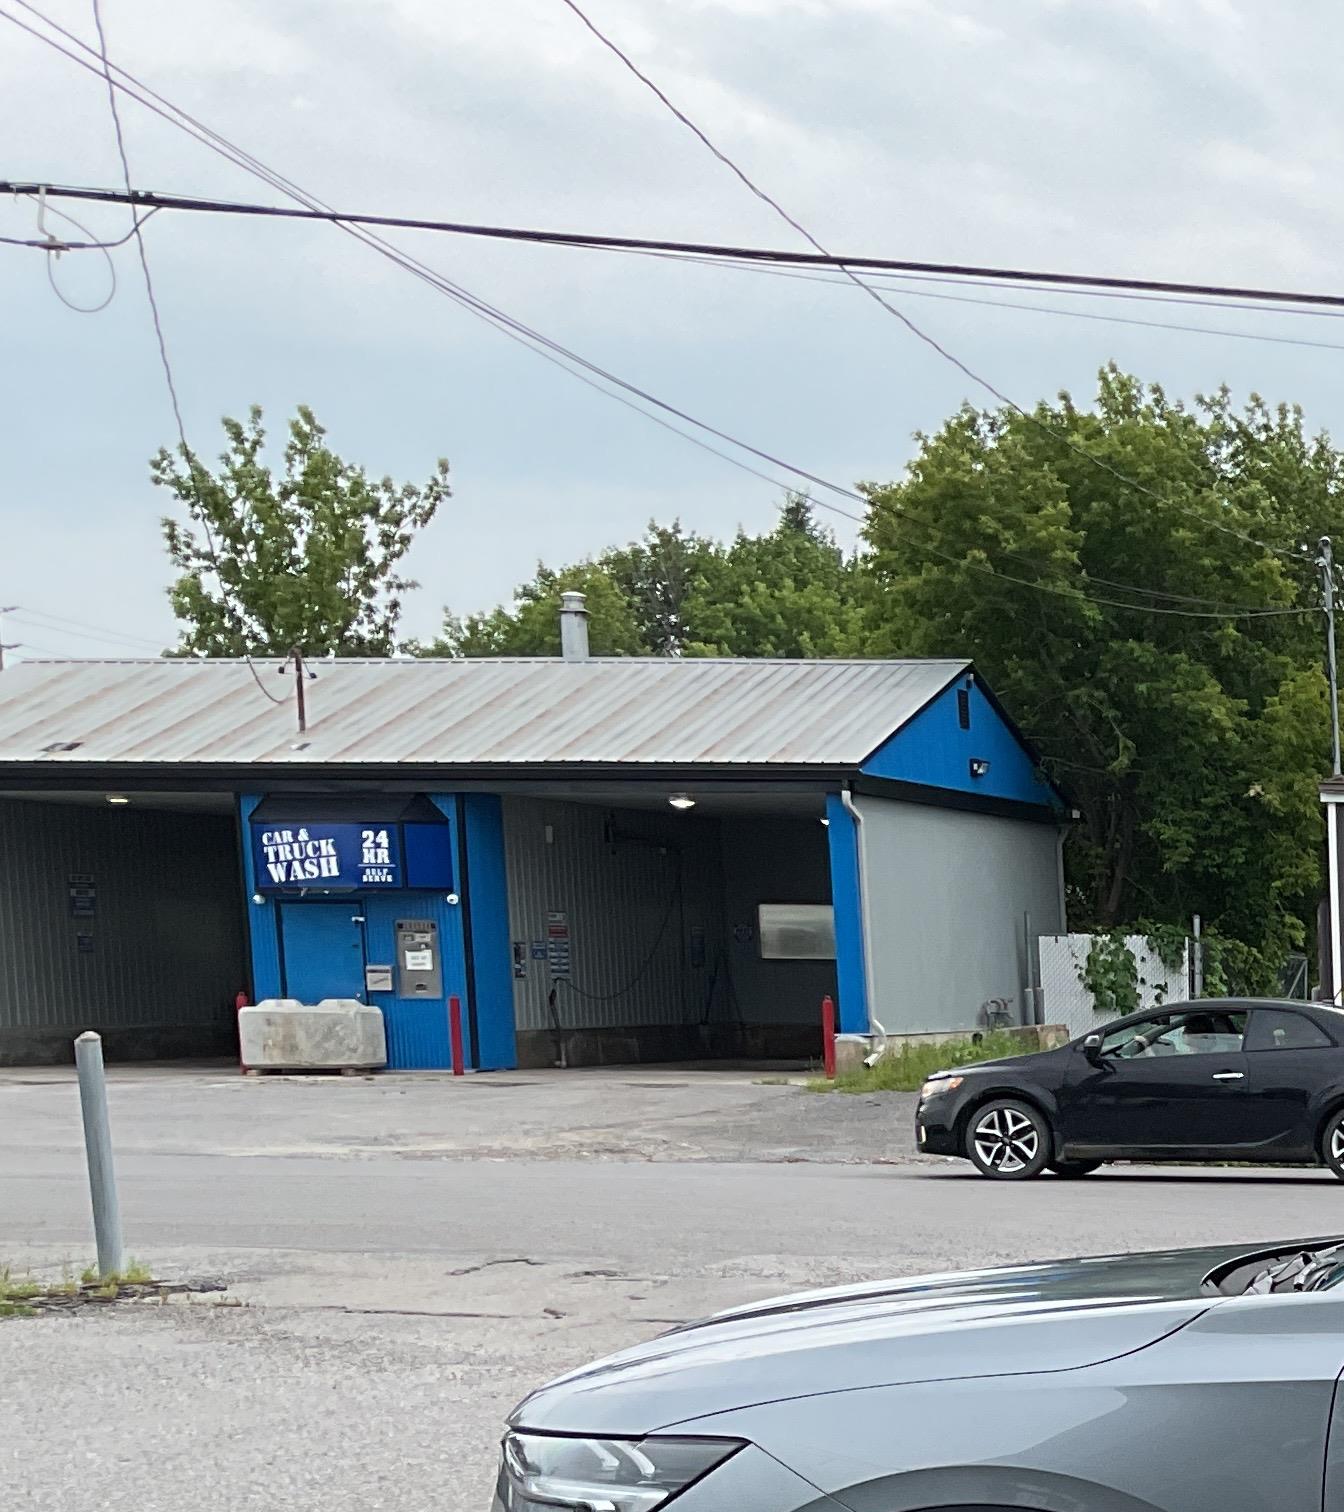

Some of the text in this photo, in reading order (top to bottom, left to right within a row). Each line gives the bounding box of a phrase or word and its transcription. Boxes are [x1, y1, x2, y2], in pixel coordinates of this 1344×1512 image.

[261, 828, 309, 845] CAR &
[362, 830, 389, 847] 24
[263, 838, 336, 863] TRUCK
[363, 848, 390, 864] HR
[266, 856, 339, 883] WASH
